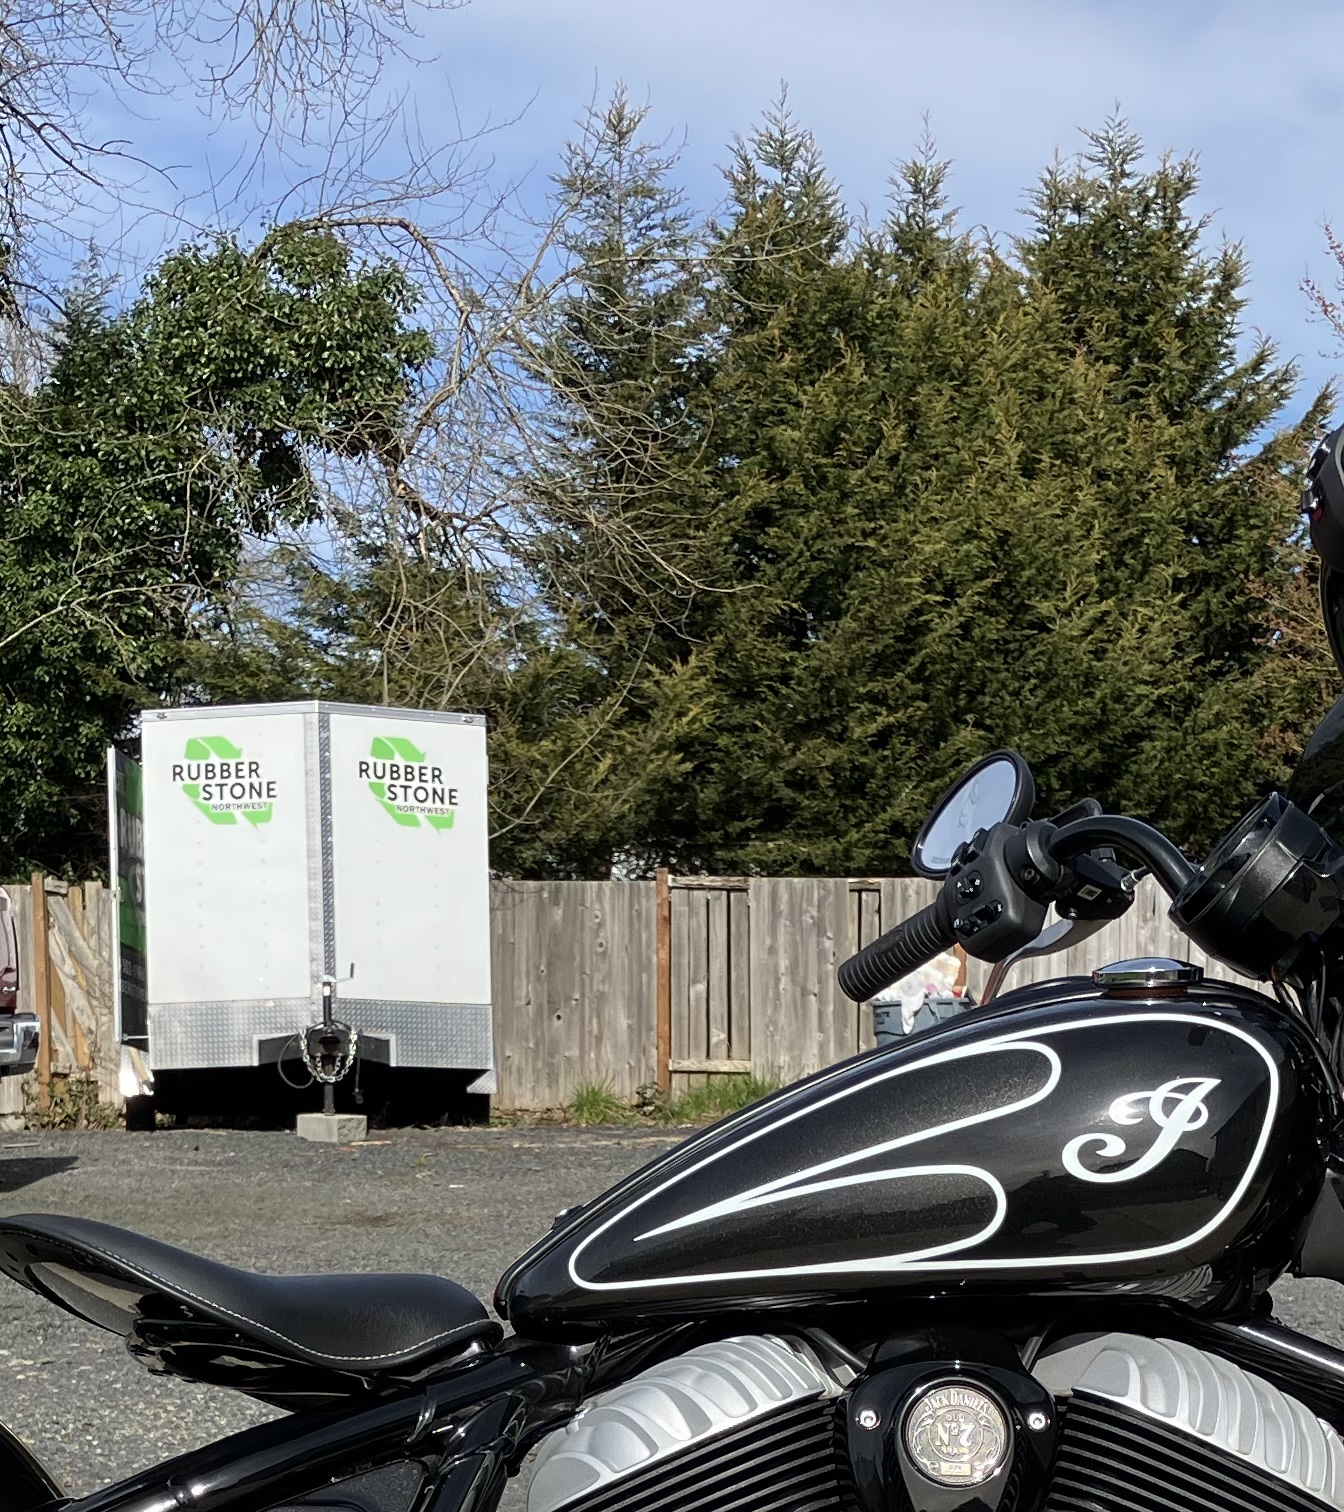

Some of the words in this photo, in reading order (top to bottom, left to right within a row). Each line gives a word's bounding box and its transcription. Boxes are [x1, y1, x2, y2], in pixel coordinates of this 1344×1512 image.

[172, 761, 260, 782] RUBBER
[358, 760, 443, 785] RUBBER
[202, 780, 277, 801] STONE
[387, 783, 458, 806] STONE
[211, 802, 268, 811] NORTHWEST
[396, 805, 450, 816] NORTHWEST
[924, 1394, 950, 1414] JACK
